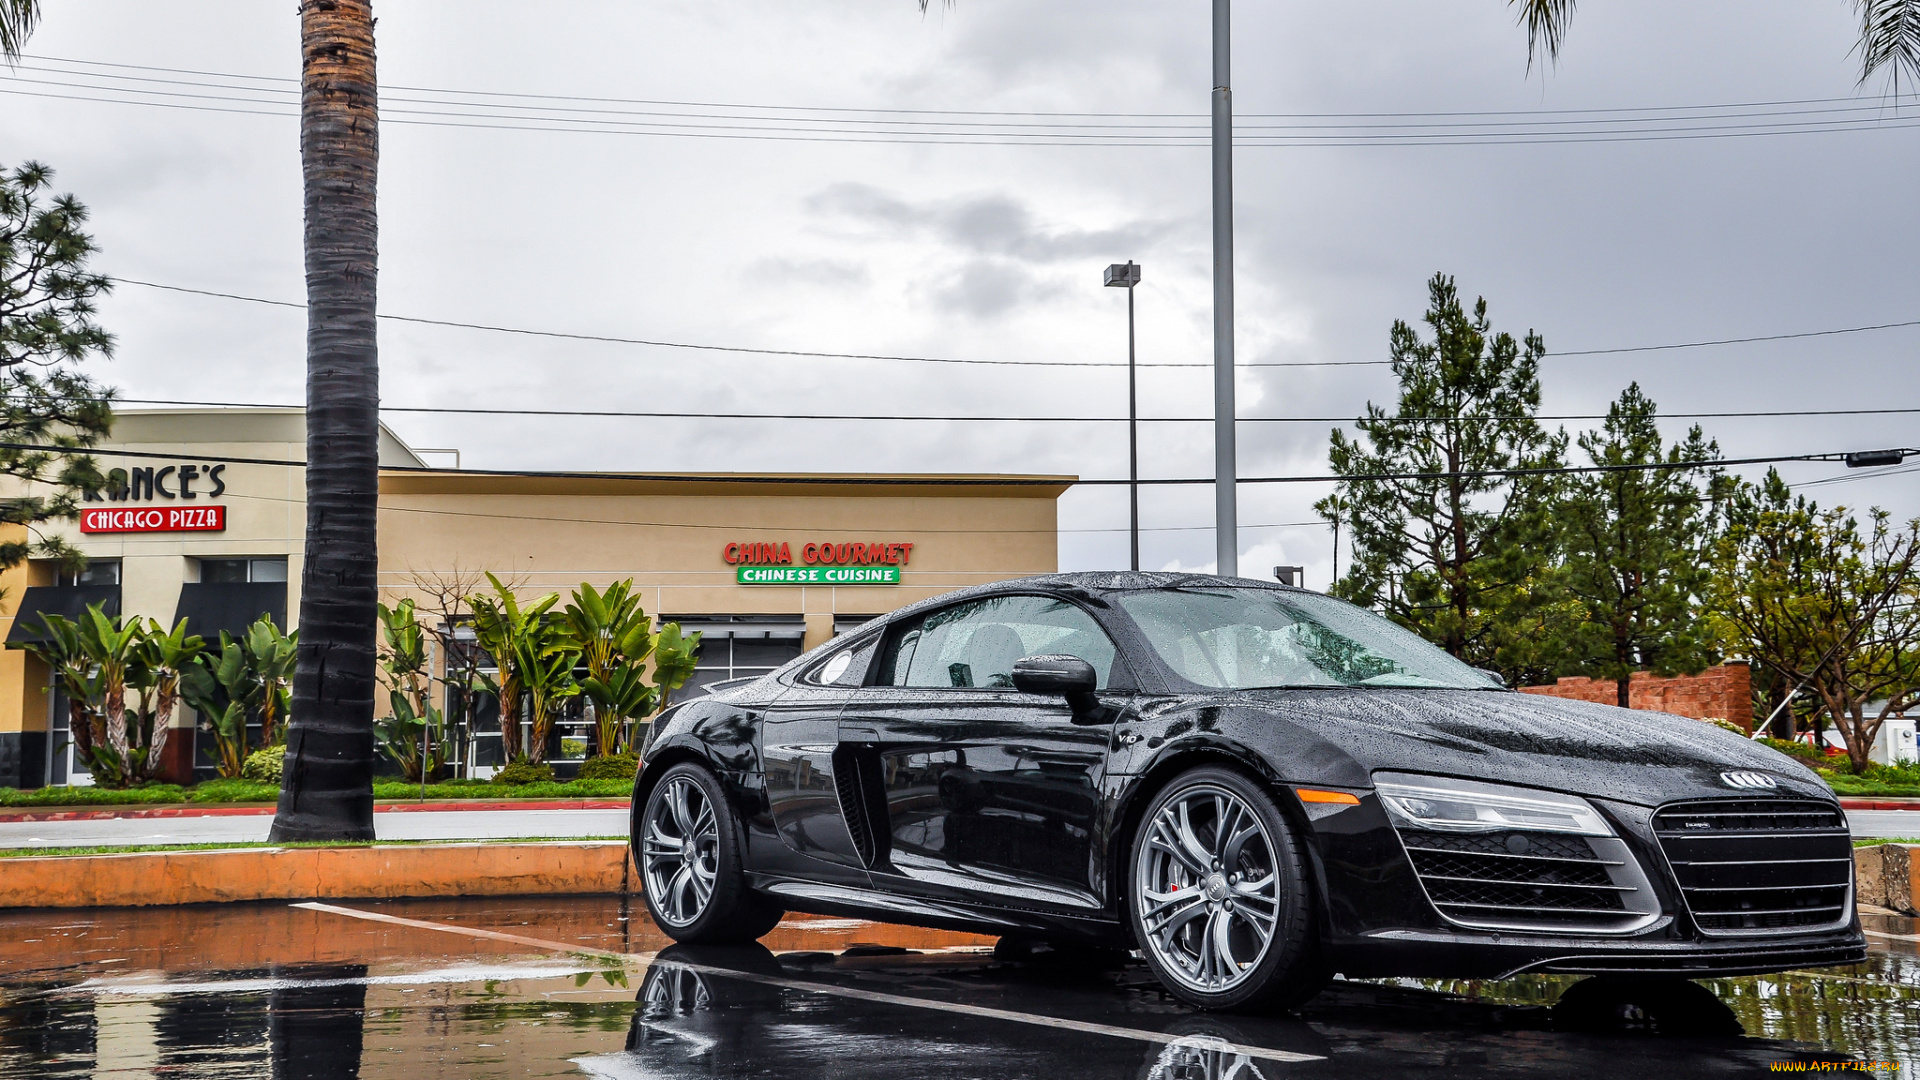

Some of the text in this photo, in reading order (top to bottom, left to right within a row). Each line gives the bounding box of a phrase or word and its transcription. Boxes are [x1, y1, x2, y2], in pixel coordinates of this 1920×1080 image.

[86, 509, 217, 529] CHICAGO PIZZA
[724, 542, 914, 565] CHINA GOURMET
[742, 569, 894, 582] CHINESE CUISINE
[1118, 734, 1137, 743] V10
